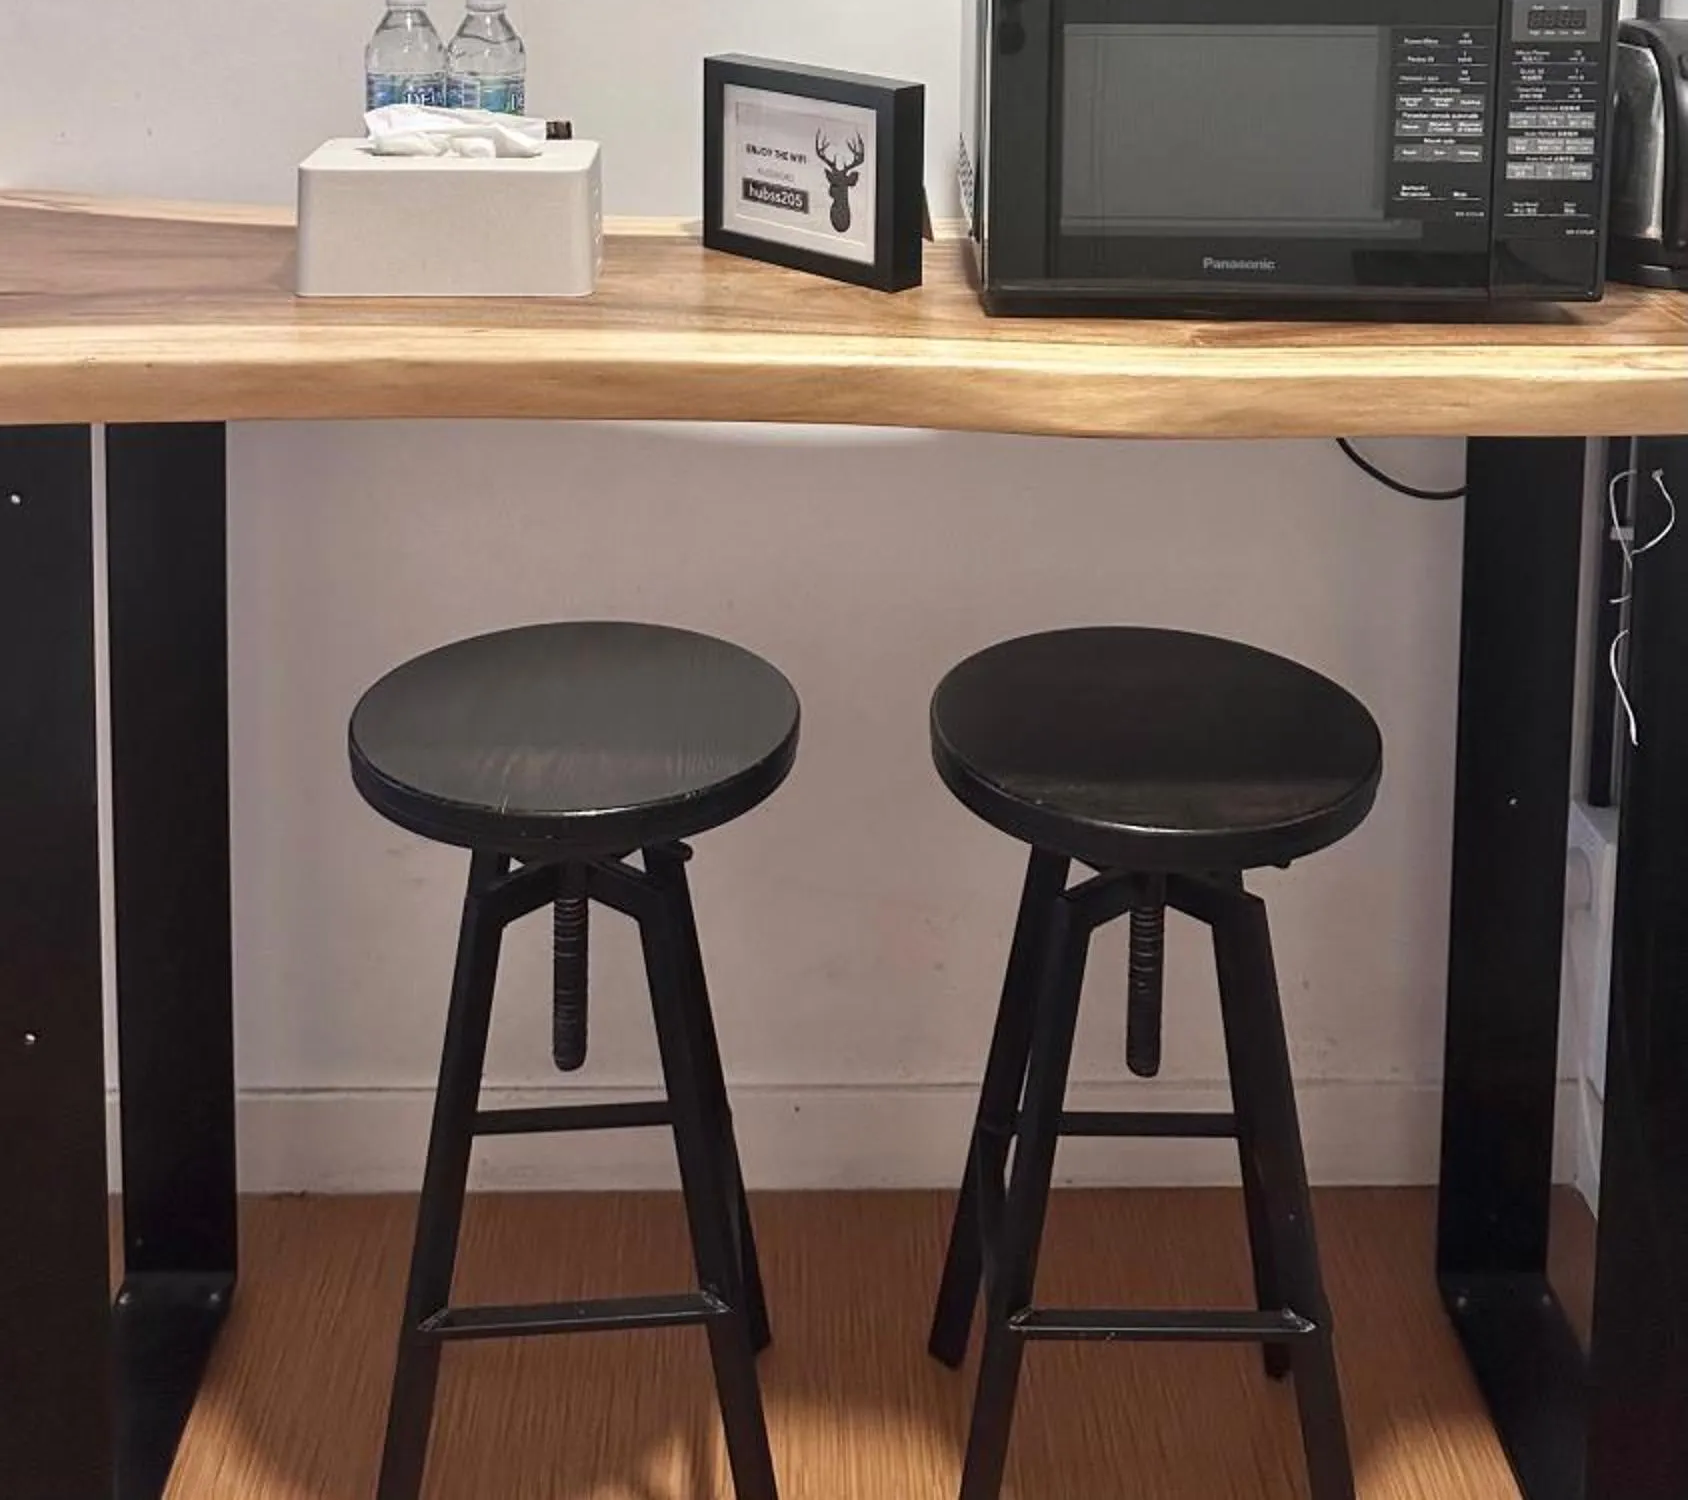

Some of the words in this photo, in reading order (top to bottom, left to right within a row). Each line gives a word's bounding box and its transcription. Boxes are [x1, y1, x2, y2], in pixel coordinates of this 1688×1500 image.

[746, 144, 773, 157] ENJOY
[774, 150, 789, 161] THE
[749, 184, 803, 208] hubss205
[1203, 257, 1276, 269] Panasonic
